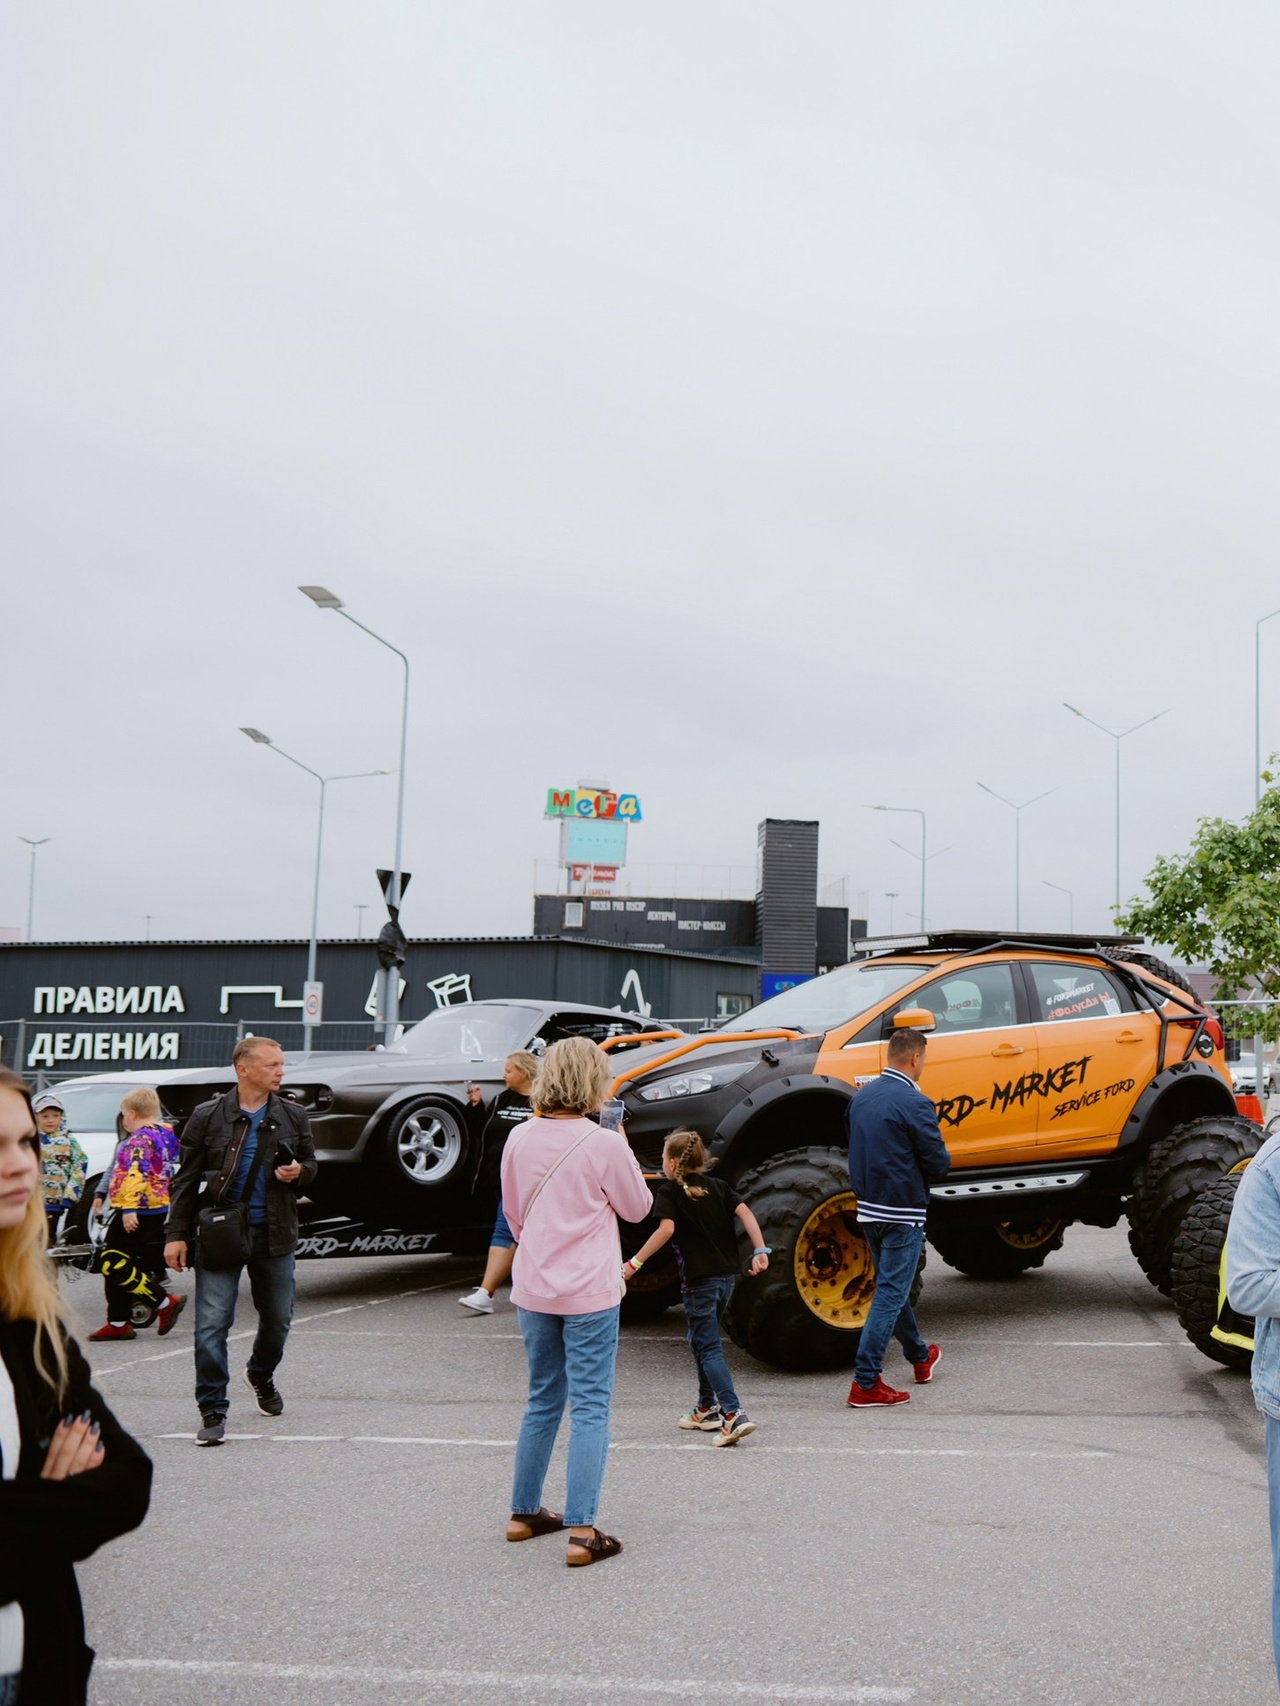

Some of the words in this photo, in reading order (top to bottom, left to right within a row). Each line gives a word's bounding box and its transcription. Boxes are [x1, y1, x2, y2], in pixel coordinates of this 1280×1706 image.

[33, 985, 186, 1014] ПРАВИЛА
[27, 1032, 180, 1067] ДЕЛЕНИЯ
[936, 1055, 1093, 1127] RD-MARKET
[1104, 1078, 1135, 1098] FORD
[294, 1233, 439, 1257] ORD-MARKET
